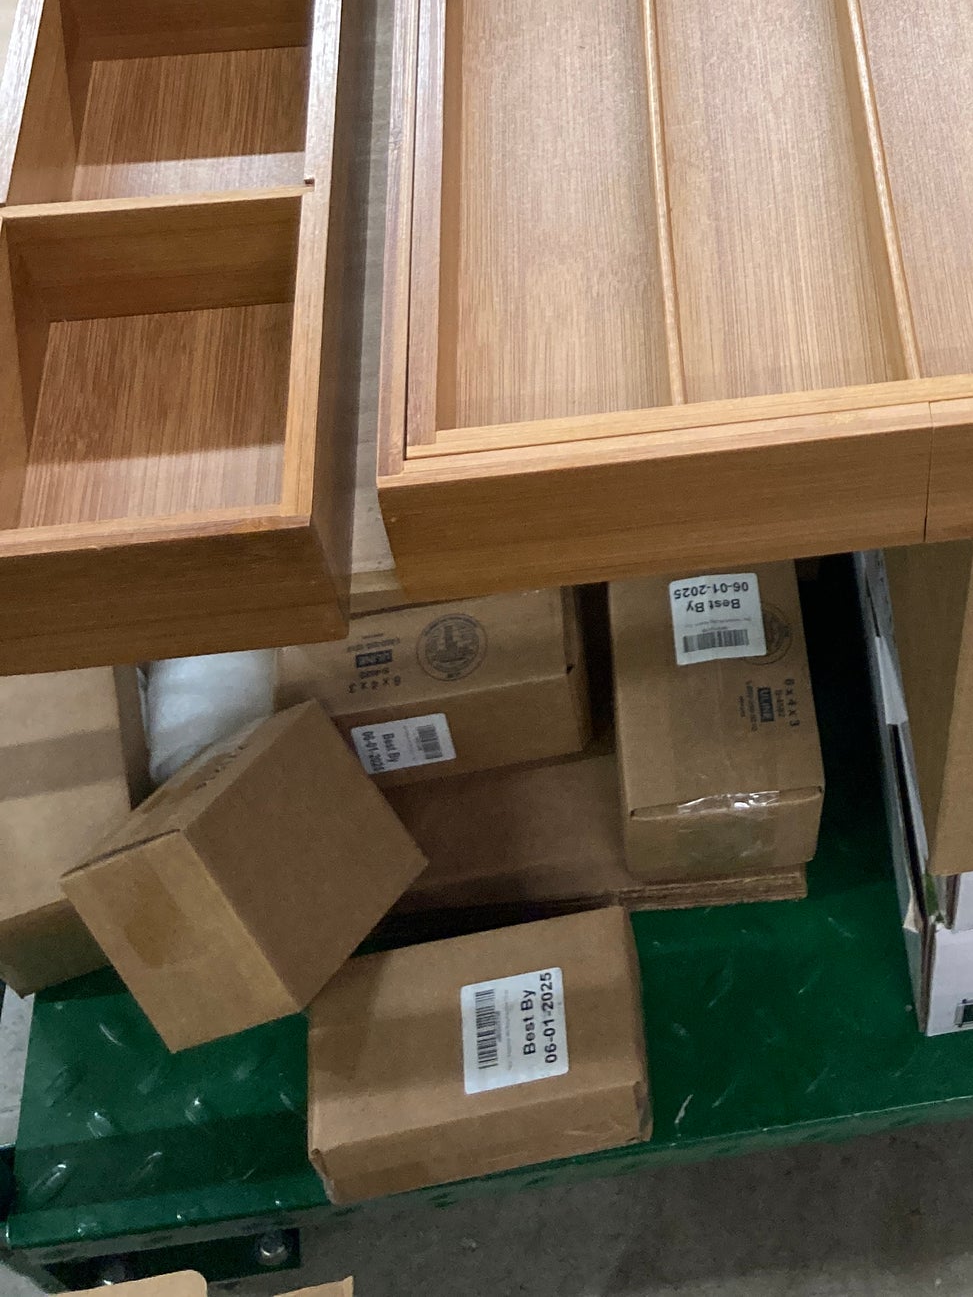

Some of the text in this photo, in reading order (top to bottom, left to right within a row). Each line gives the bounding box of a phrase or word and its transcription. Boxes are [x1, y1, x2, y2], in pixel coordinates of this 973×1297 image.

[673, 581, 750, 600] 06-01-2025
[686, 598, 741, 613] Best By
[381, 732, 397, 752] Best
[520, 989, 537, 1056] Best By
[539, 972, 558, 1064] 06-01-2025
